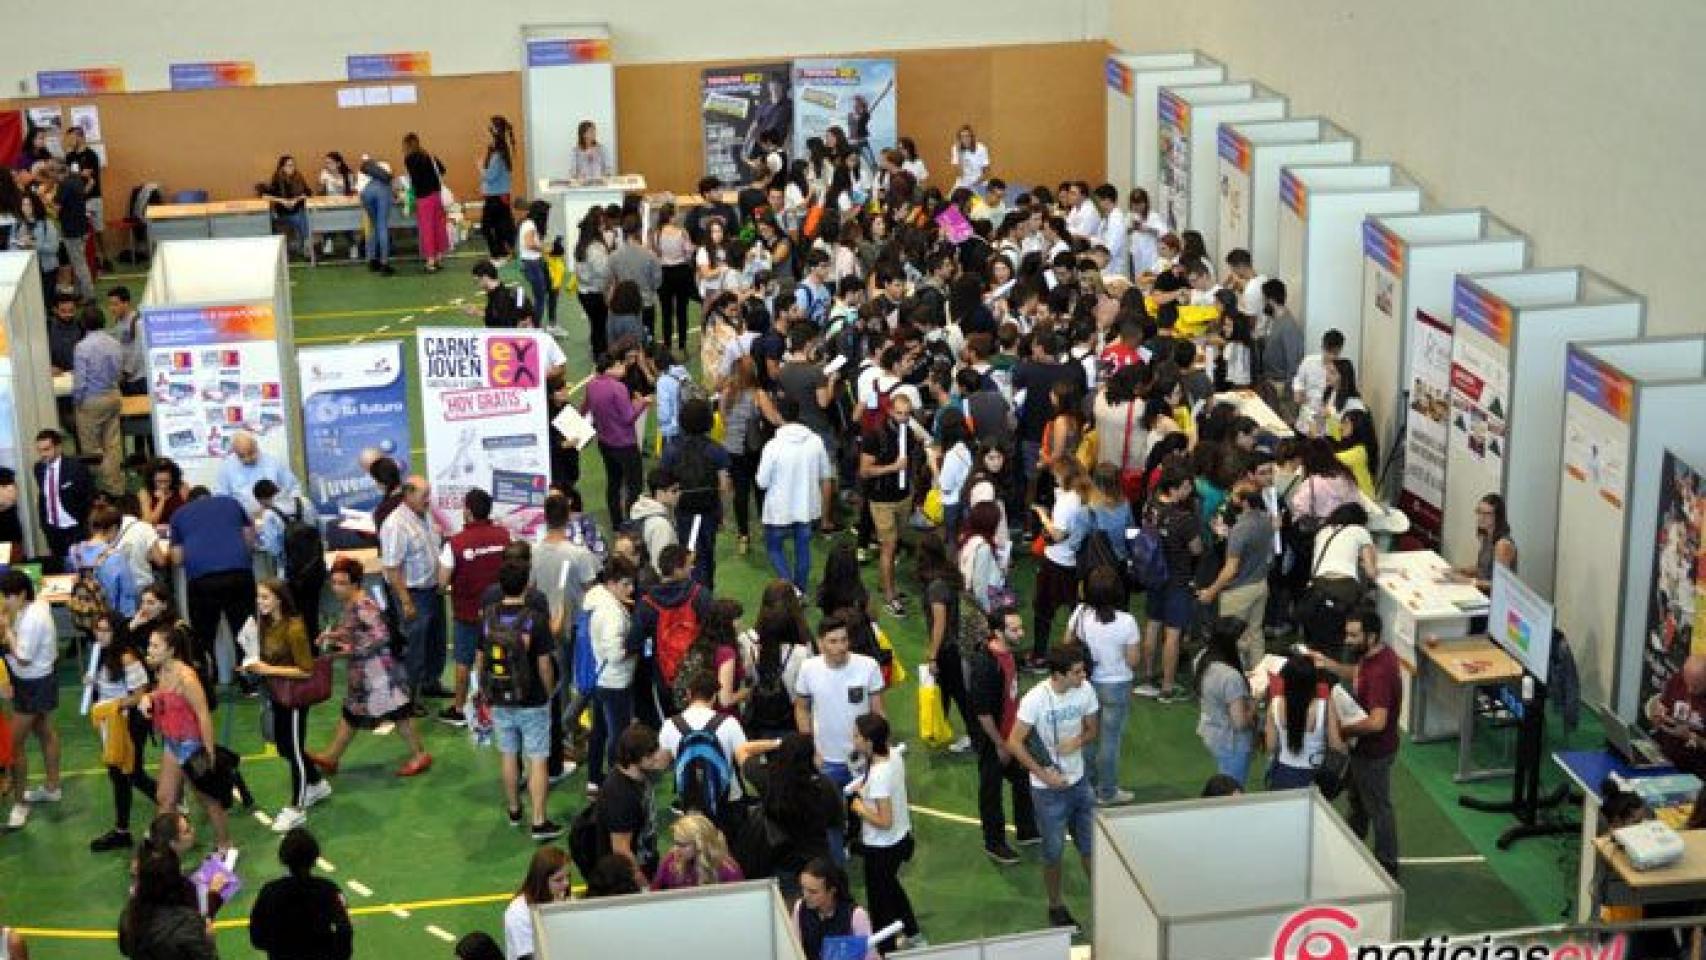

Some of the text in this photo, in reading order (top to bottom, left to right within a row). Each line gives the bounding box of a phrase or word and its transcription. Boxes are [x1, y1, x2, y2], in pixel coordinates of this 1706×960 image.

[427, 357, 481, 378] JOVEN
[448, 390, 521, 413] HOY GRATIS
